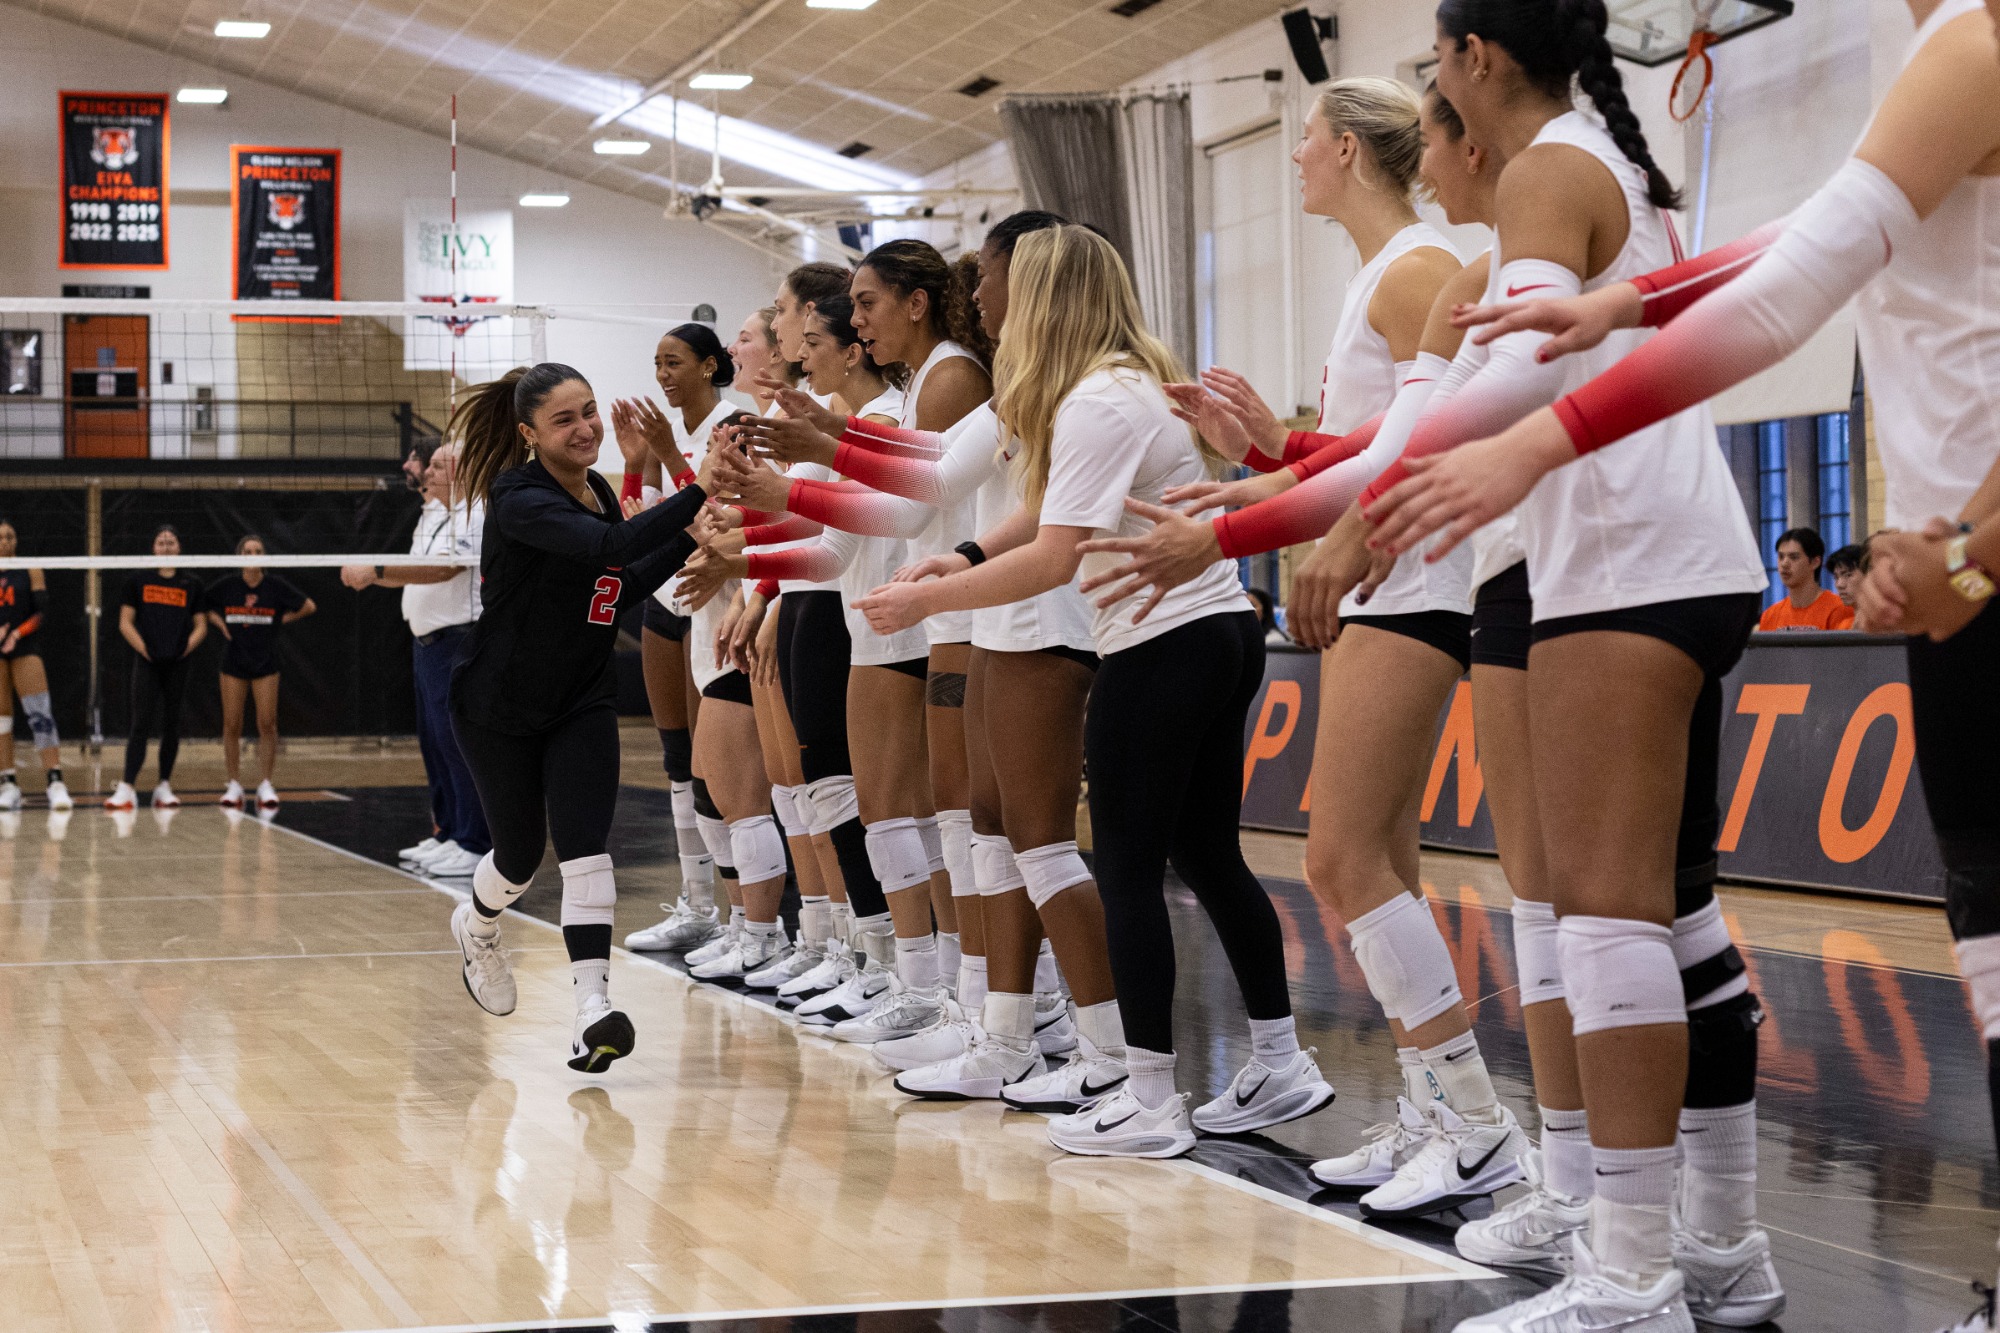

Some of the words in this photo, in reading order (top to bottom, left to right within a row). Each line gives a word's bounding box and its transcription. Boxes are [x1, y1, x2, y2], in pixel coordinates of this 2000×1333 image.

[96, 171, 133, 185] EIVA
[241, 165, 332, 181] PRINCETON
[69, 185, 159, 201] CHAMPIONS
[70, 202, 111, 220] 1998
[117, 203, 159, 222] 2019
[70, 222, 112, 241] 2022
[441, 234, 497, 257] IVY
[587, 575, 622, 626] 2
